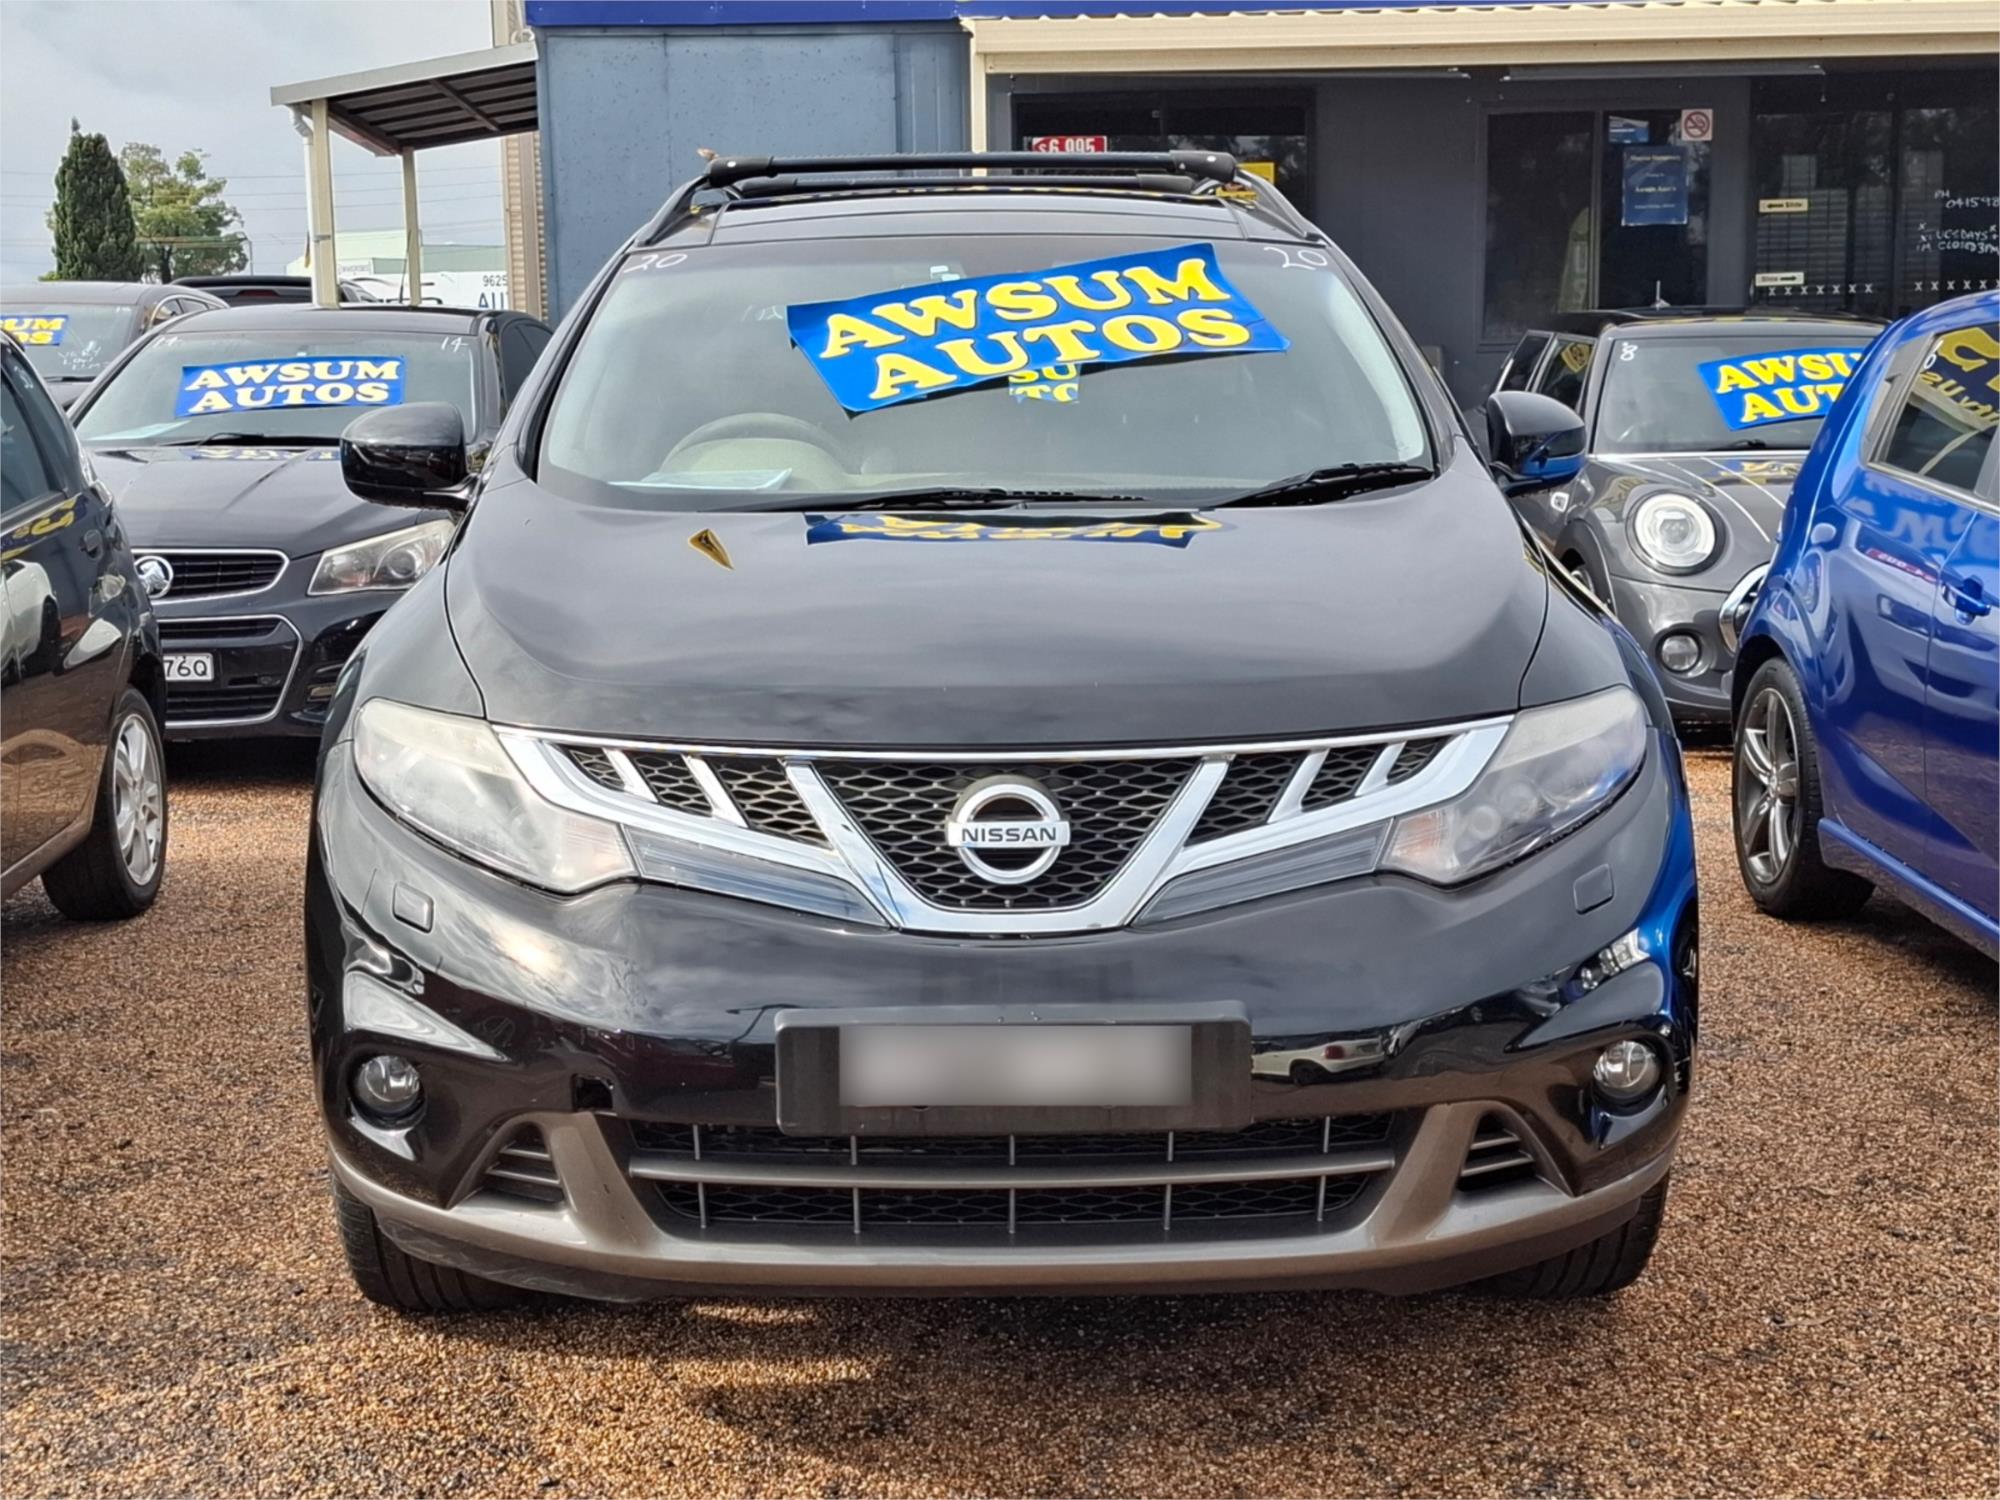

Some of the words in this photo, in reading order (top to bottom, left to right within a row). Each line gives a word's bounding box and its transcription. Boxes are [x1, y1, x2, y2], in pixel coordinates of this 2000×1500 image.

[623, 253, 688, 273] 20
[1263, 246, 1328, 271] 20
[478, 292, 509, 310] AU
[819, 258, 1231, 359] AWSUM
[0, 318, 66, 331] UM
[869, 308, 1251, 400] AUTOS
[184, 360, 400, 391] AWSUM
[188, 382, 389, 413] AUTOS
[961, 827, 1056, 842] NISSAN
